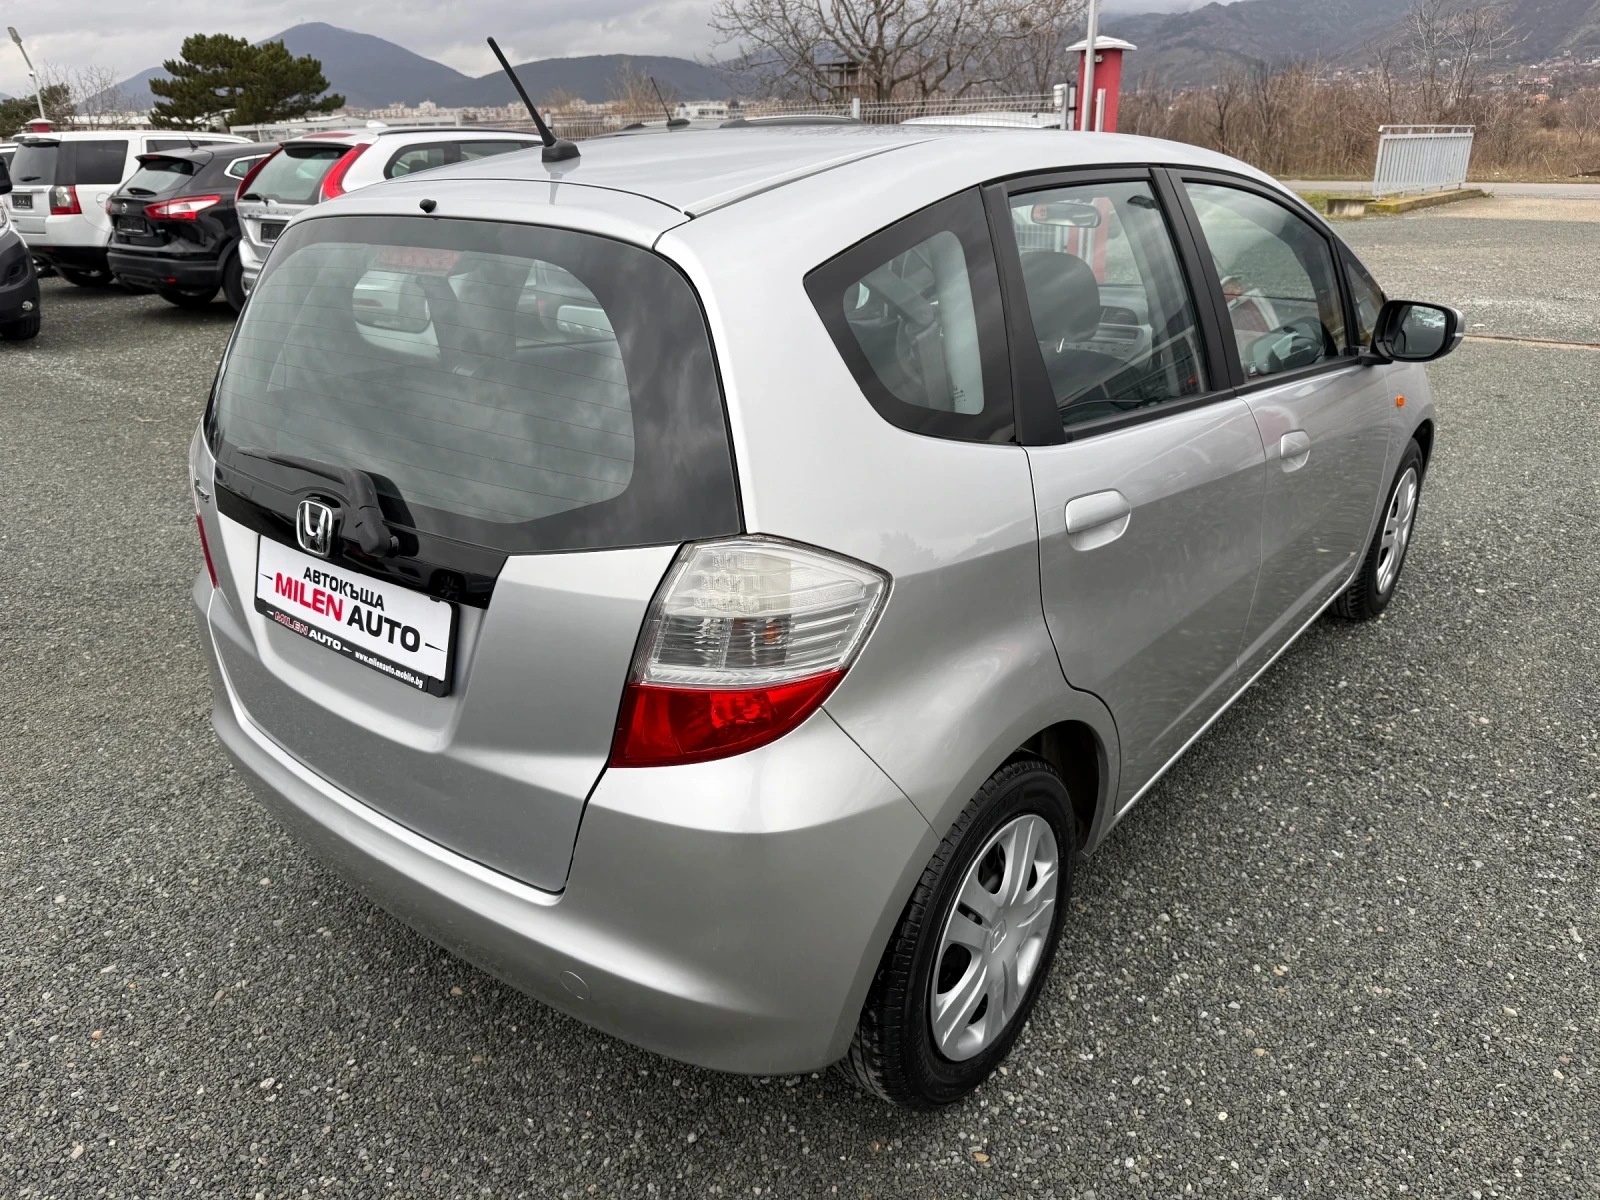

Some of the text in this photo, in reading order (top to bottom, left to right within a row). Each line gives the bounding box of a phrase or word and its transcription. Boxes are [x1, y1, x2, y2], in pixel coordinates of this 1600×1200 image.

[274, 611, 424, 689] MILEN AUTO www.milenauto.mobile.bg
[275, 572, 420, 652] MILEN AUTO
